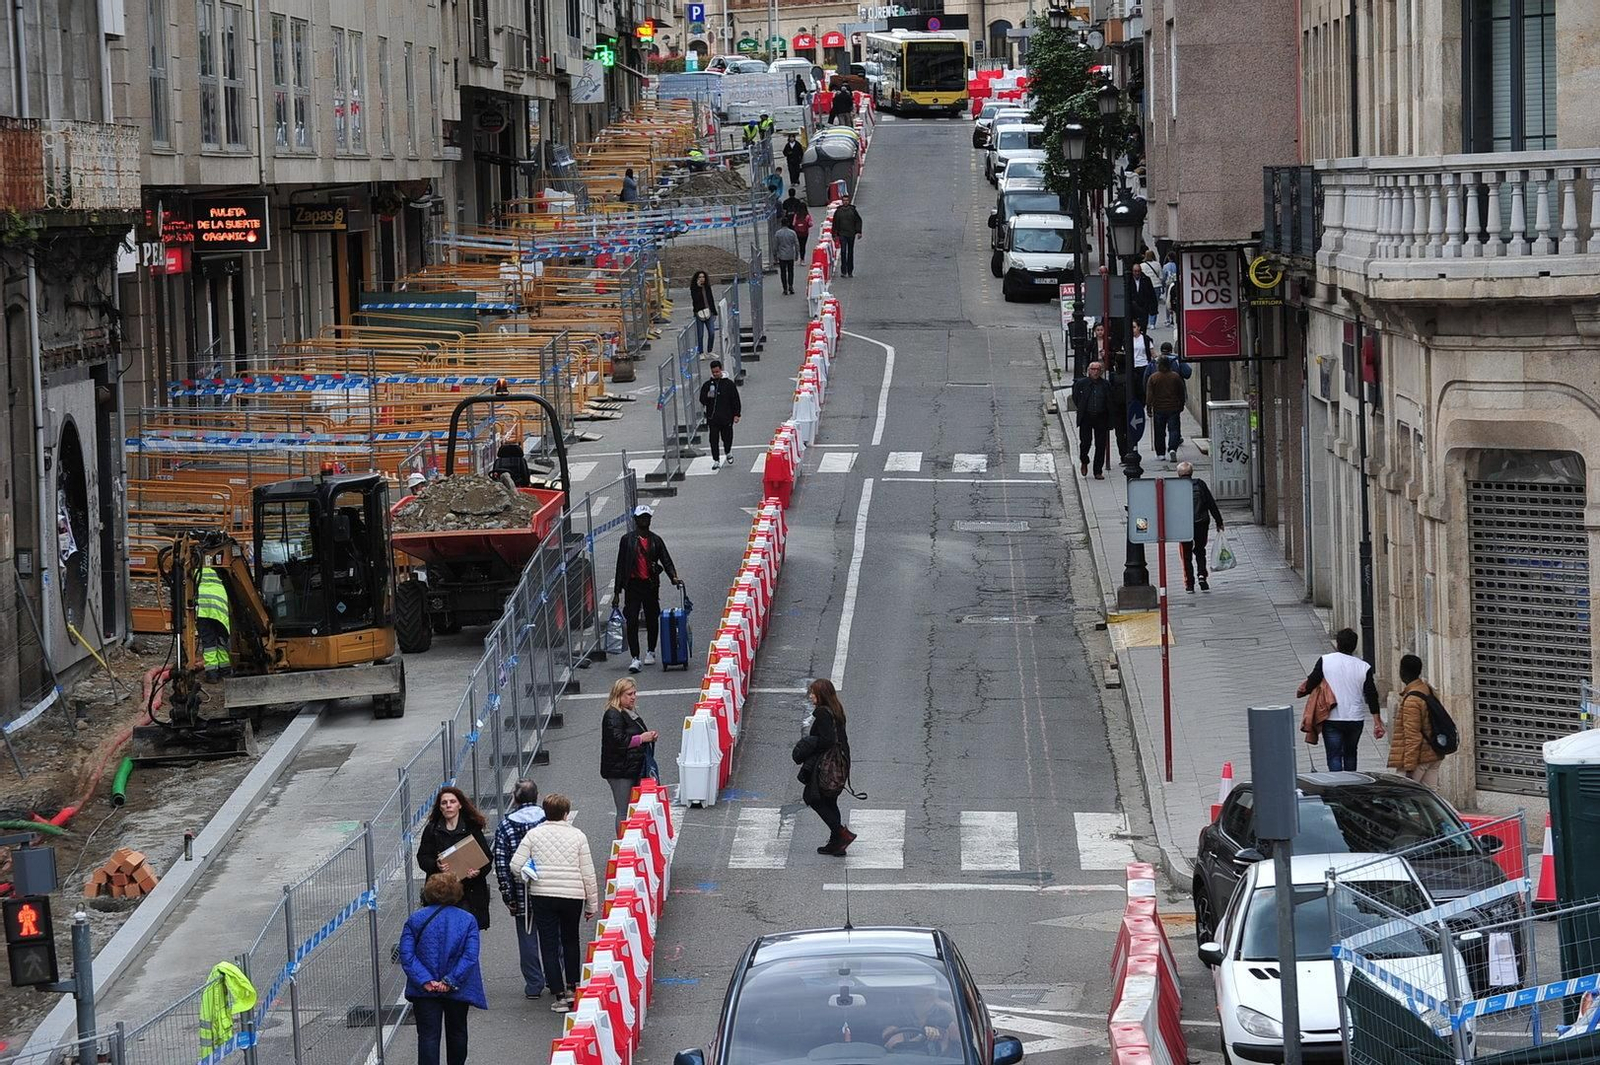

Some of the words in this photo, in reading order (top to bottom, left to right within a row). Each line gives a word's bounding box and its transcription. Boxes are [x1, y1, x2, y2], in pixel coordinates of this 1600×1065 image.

[692, 6, 701, 20] P
[827, 36, 839, 44] AVIS
[209, 207, 247, 218] RULETA
[295, 207, 334, 226] Zapas
[197, 220, 210, 229] DE
[211, 220, 224, 229] LA
[225, 219, 261, 229] SUERTE
[202, 231, 246, 242] ORGANIC
[1190, 253, 1228, 270] LOS
[1190, 270, 1231, 288] NAR
[1191, 288, 1232, 305] DOS
